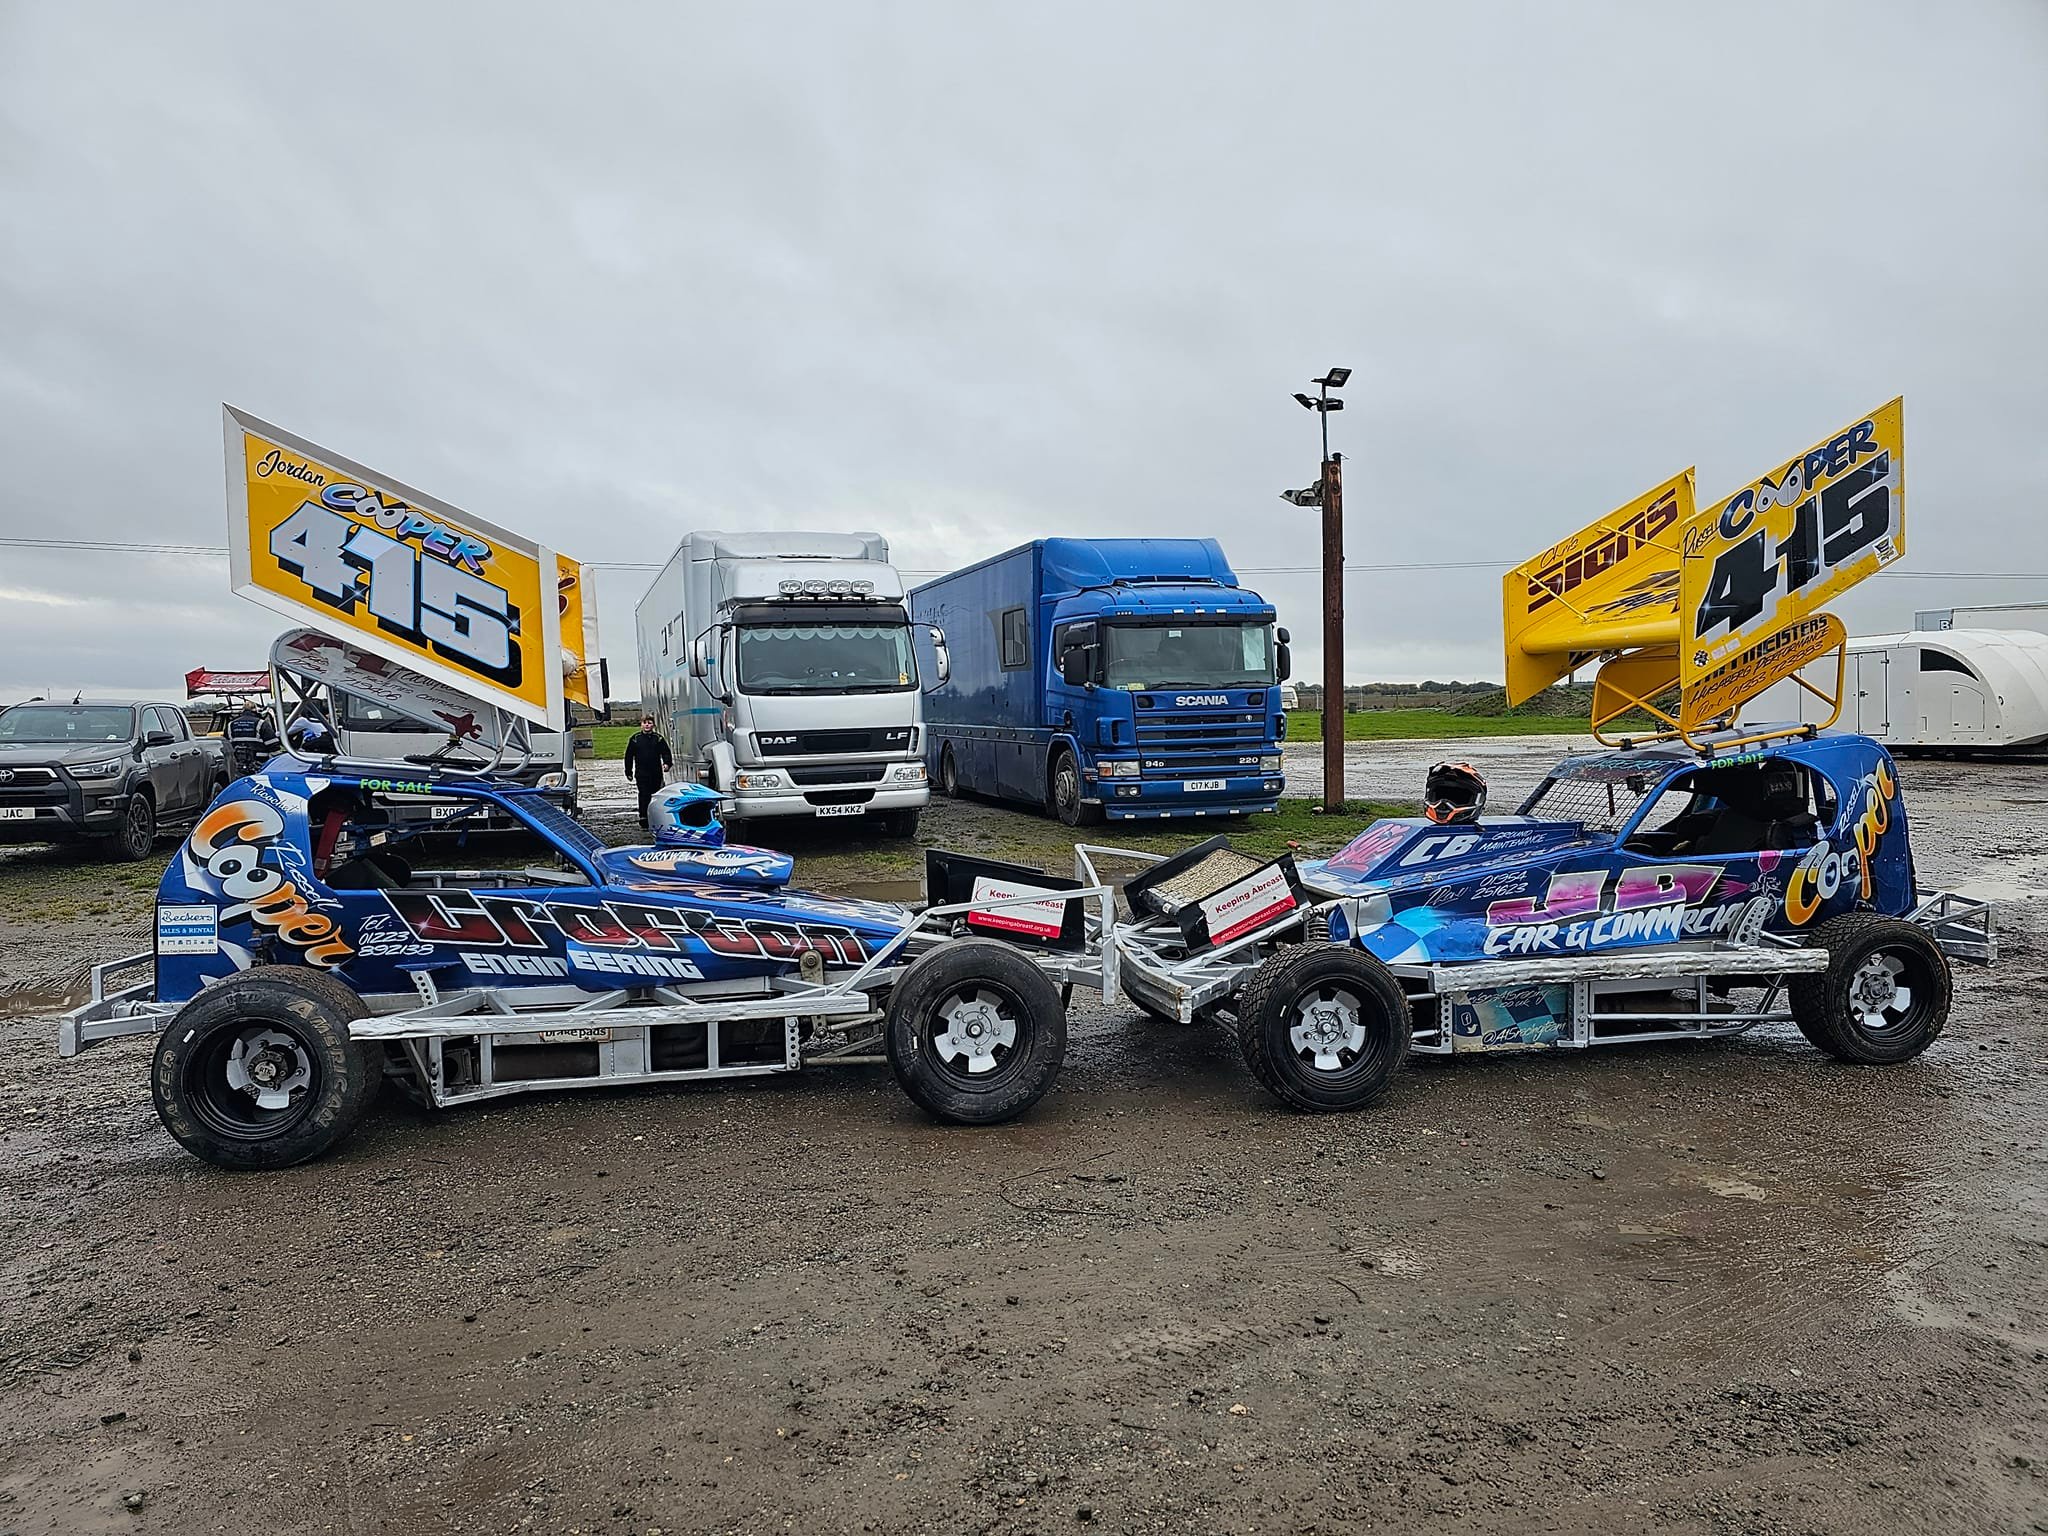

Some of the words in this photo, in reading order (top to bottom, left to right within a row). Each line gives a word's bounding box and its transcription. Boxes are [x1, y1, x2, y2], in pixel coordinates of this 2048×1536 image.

[256, 450, 326, 487] Jordan
[1719, 420, 1878, 540] COOPER
[321, 483, 492, 575] COOPER
[1541, 537, 1578, 568] Chris
[1696, 449, 1892, 640] 415
[270, 500, 514, 680] 415
[1753, 627, 1829, 676] PERFORMANCE
[1175, 694, 1229, 707] SCANIA
[760, 736, 798, 745] DAF
[885, 732, 909, 740] LF
[1239, 756, 1259, 764] 220
[1711, 758, 1734, 770] FOR
[1737, 752, 1765, 767] SALE
[360, 778, 391, 791] FOR
[396, 781, 433, 794] SALE
[1204, 780, 1219, 789] KJB
[250, 782, 300, 815] Ricochet
[819, 806, 843, 816] KX54
[844, 805, 863, 814] KKZ
[2, 808, 24, 818] JAC
[1400, 834, 1480, 867] CB
[1785, 757, 1895, 926] Cooper
[638, 850, 699, 862] CORNWELL
[191, 800, 355, 967] Cooper
[706, 866, 741, 877] Haulage
[1215, 891, 1251, 914] Keeping
[1251, 874, 1284, 895] Abreast
[978, 915, 1051, 933] www.keepingabreast.org.uk
[358, 931, 410, 945] 01223
[1484, 925, 1561, 956] CAR
[358, 944, 434, 957] 892138
